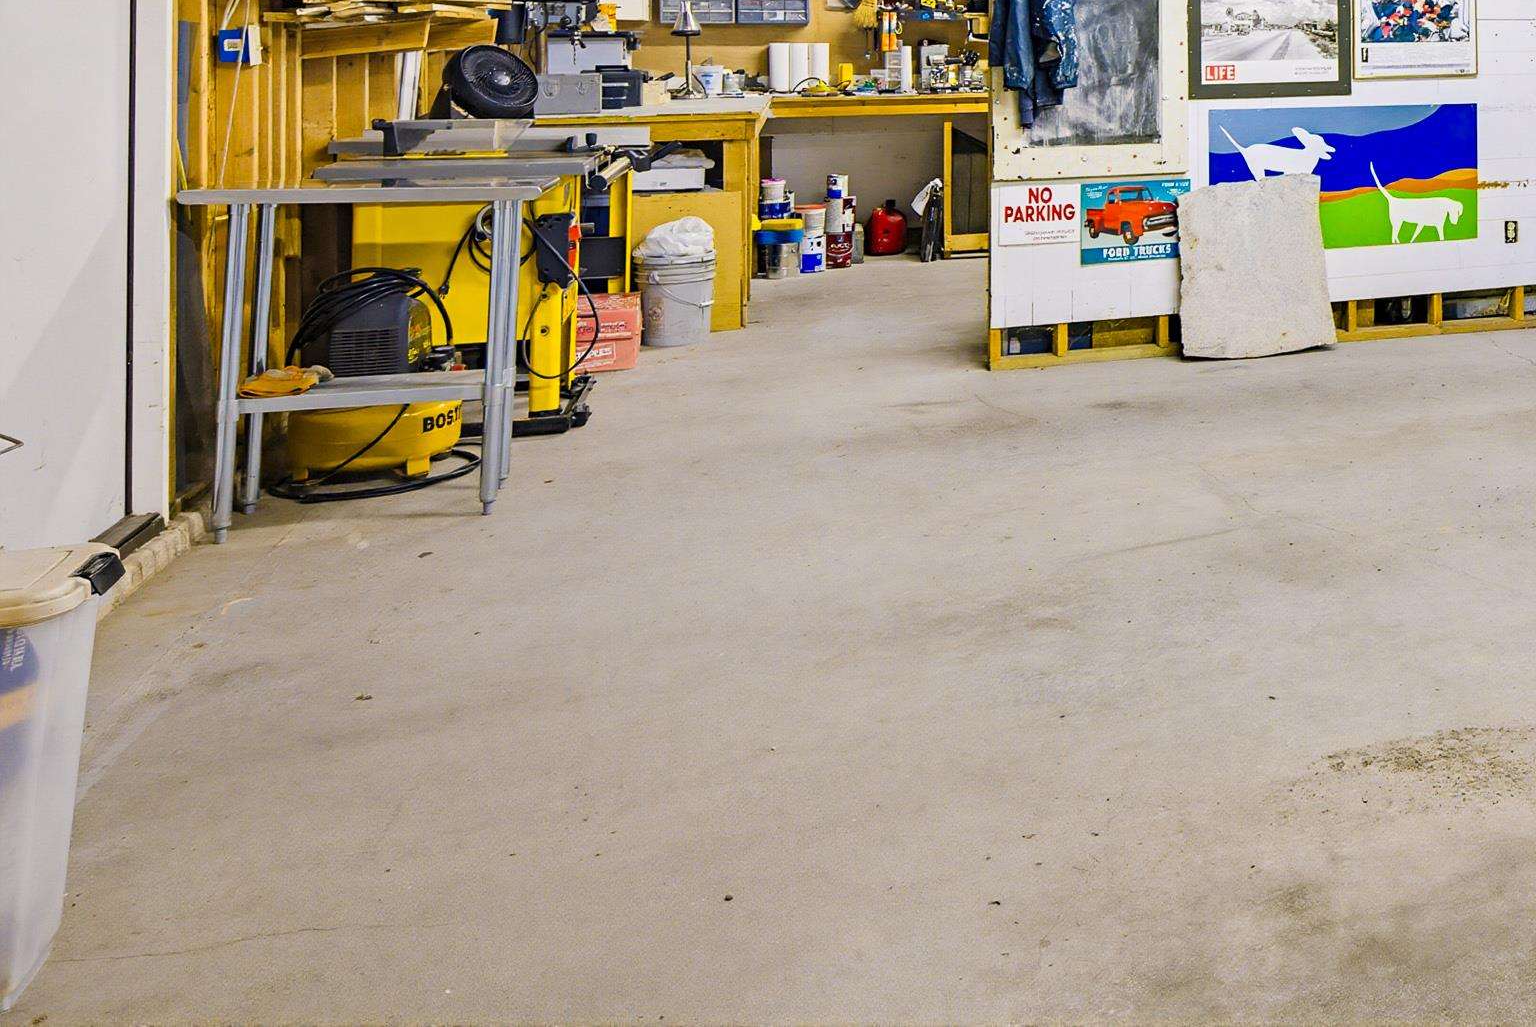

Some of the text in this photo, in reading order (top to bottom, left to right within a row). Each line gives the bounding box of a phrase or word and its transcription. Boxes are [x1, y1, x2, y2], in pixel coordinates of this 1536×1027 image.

[1205, 64, 1236, 81] LIFE
[1028, 187, 1053, 204] NO
[1004, 204, 1076, 224] PARKING
[1103, 246, 1130, 259] FORD
[1133, 244, 1172, 257] TRUCKS
